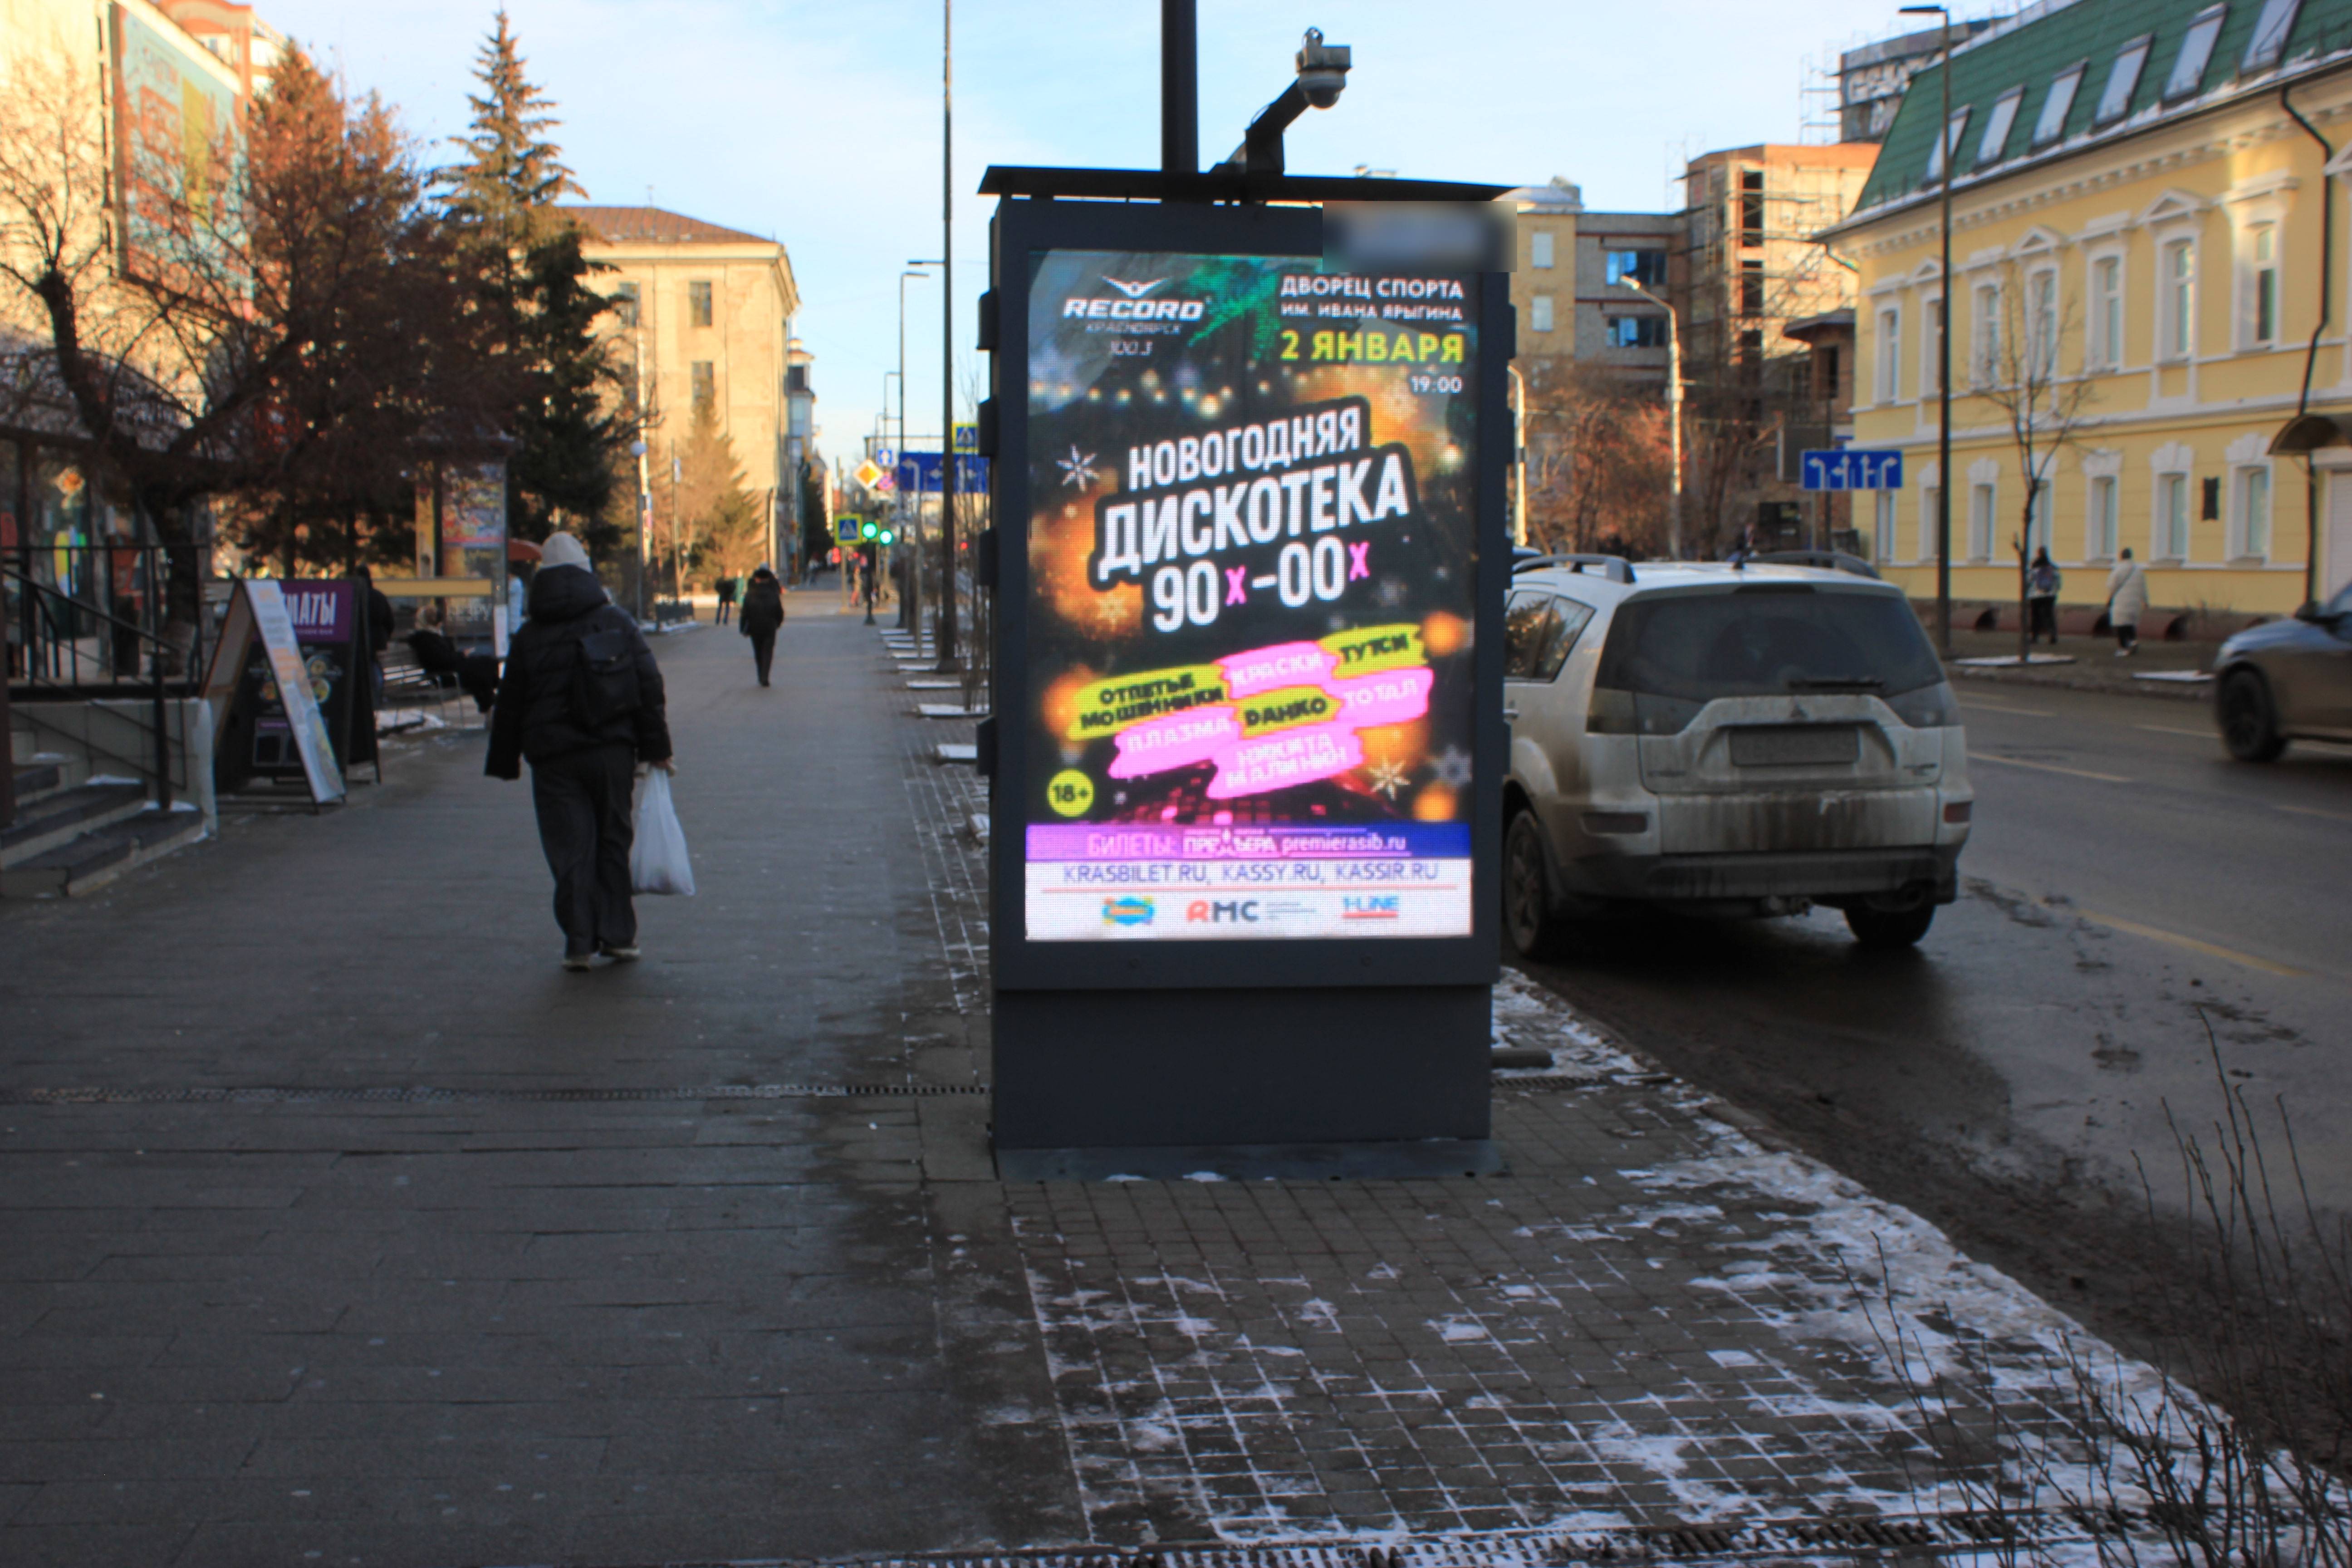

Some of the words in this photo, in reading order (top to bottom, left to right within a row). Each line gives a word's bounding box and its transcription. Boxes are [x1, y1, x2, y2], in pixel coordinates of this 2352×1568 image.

[1280, 275, 1371, 299] ДВОРЕЦ
[1376, 278, 1465, 300] СПОРТА
[1063, 299, 1204, 321] RECORD
[1318, 302, 1378, 318] ИВАНА
[1280, 329, 1300, 361] 2
[1311, 330, 1465, 363] ЯНВАРЯ
[1411, 375, 1462, 393] 19:00
[1129, 406, 1361, 491] НОВОГОДНЯЯ
[1098, 453, 1410, 581] ДИСКОТЕКА
[1053, 784, 1089, 803] 18+
[1282, 833, 1406, 856] premierasib.ru
